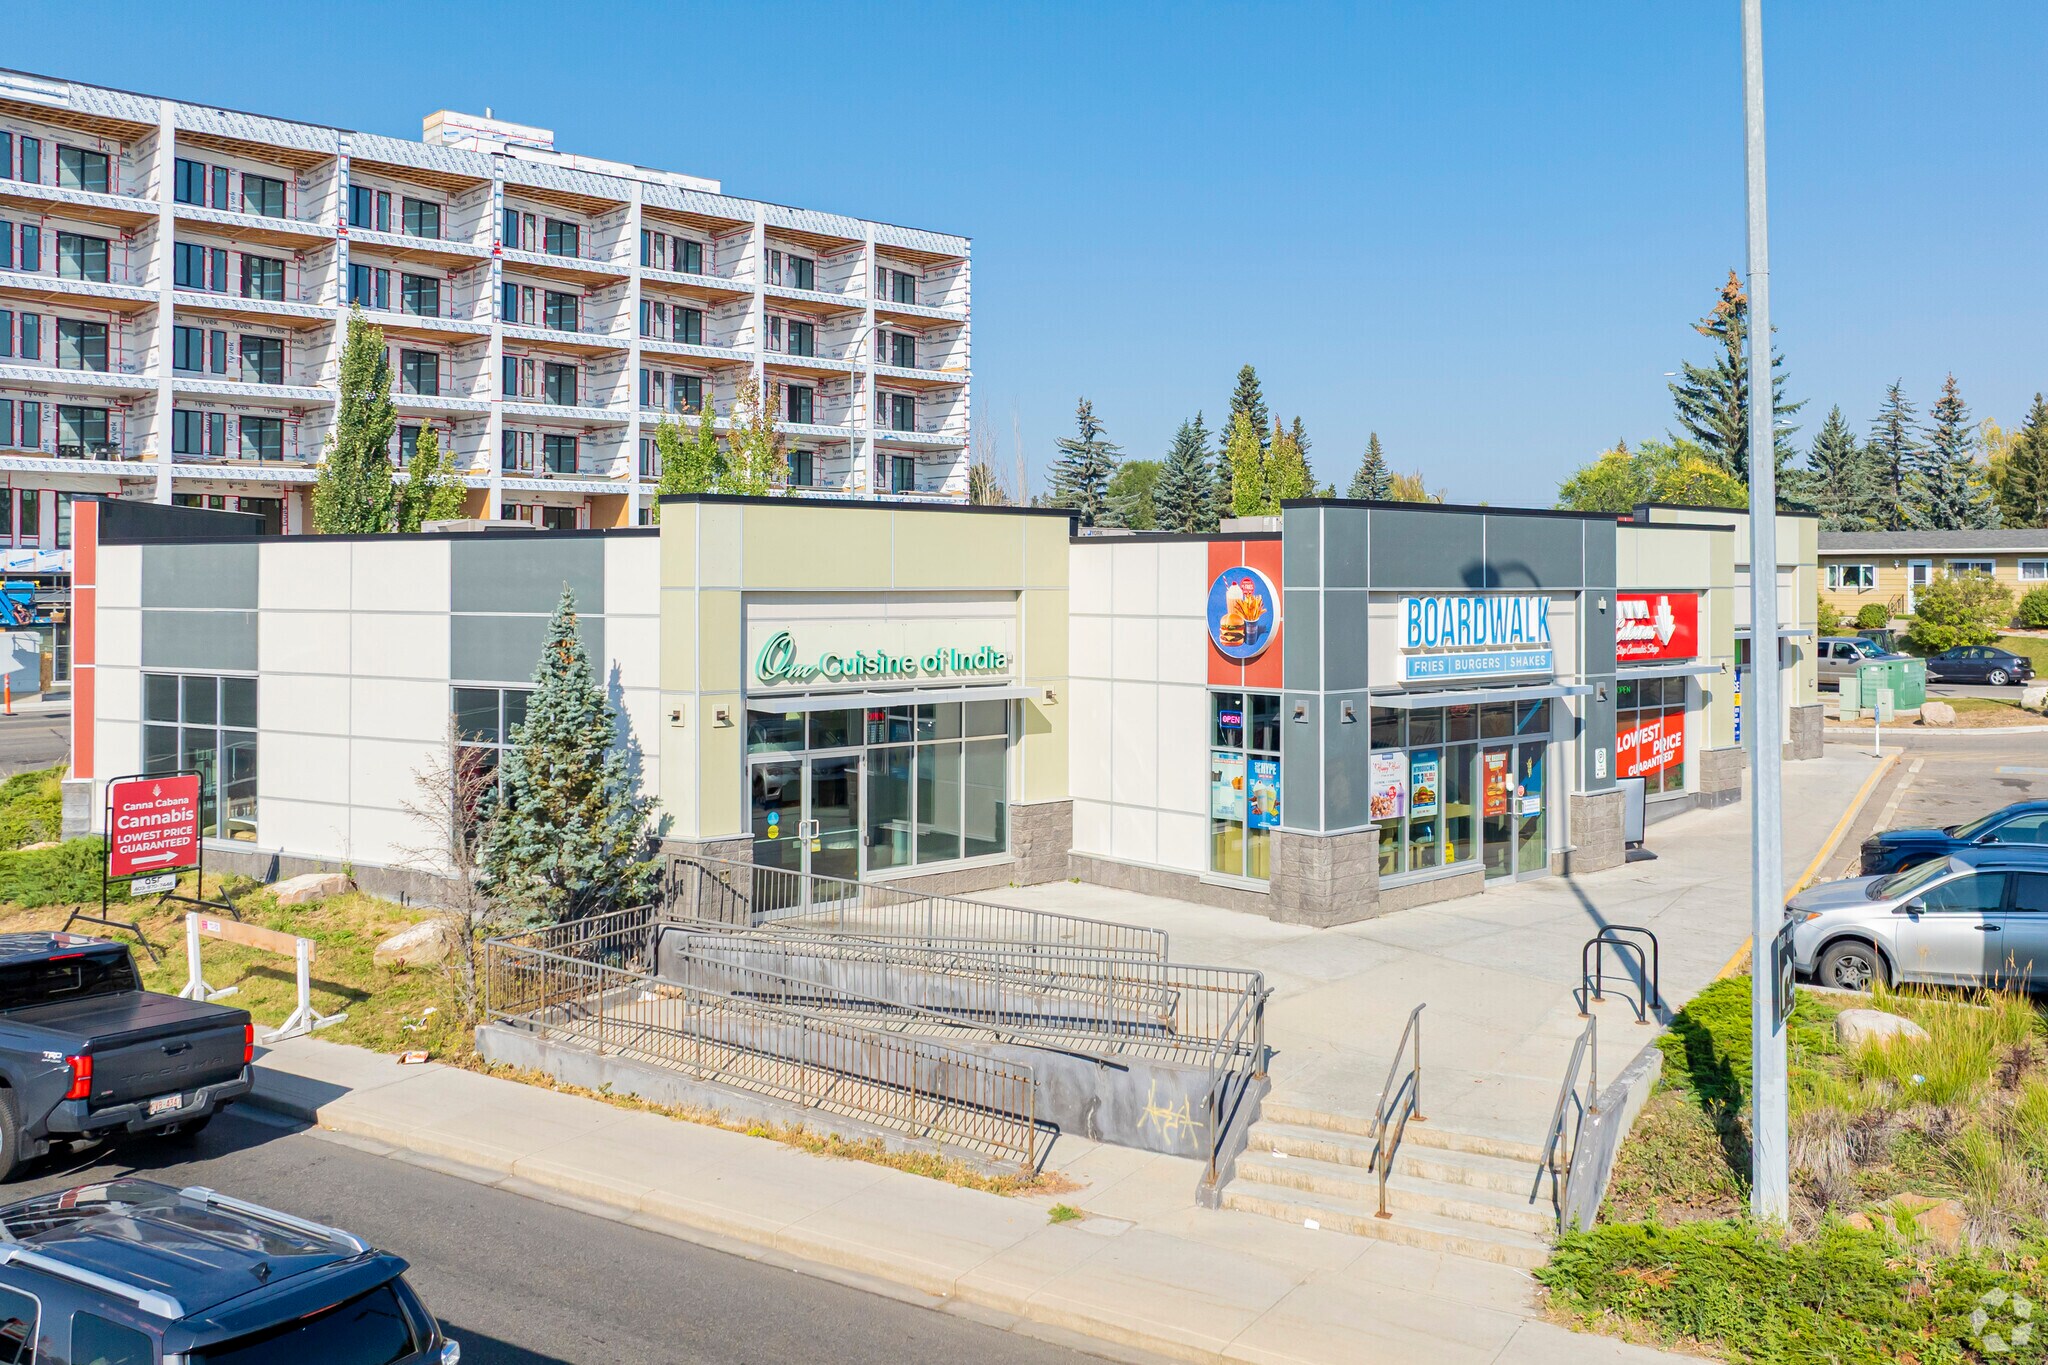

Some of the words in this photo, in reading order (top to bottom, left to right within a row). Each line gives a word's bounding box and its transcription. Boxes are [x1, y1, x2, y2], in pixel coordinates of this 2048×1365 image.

[197, 316, 219, 326] Tyvek
[231, 321, 253, 330] Tyvek
[265, 326, 286, 335] Tyvek
[24, 390, 49, 398] Tyvek
[65, 393, 89, 401] Tyvek
[194, 401, 216, 409] Tyvek
[229, 403, 250, 411] Tyvek
[1407, 597, 1551, 647] BOARDWALK
[755, 630, 819, 681] Om
[819, 649, 916, 677] Cuisine
[920, 647, 949, 671] of
[951, 645, 1008, 671] India
[1414, 660, 1444, 673] FRIES
[1455, 657, 1500, 670] BURGERS
[1510, 655, 1546, 668] SHAKES
[1222, 714, 1241, 724] OPEN
[1617, 722, 1661, 753] LOWEST
[1653, 731, 1682, 755] PRICE
[1261, 762, 1276, 775] HYPE
[123, 801, 153, 811] Canna
[155, 797, 189, 807] Cabana
[117, 807, 194, 829] Cannabis
[117, 830, 162, 844] LOWEST
[163, 826, 193, 837] PRICE
[119, 837, 190, 854] GUARANTEED
[42, 1050, 63, 1060] TRD
[121, 1057, 224, 1084] TACOMA
